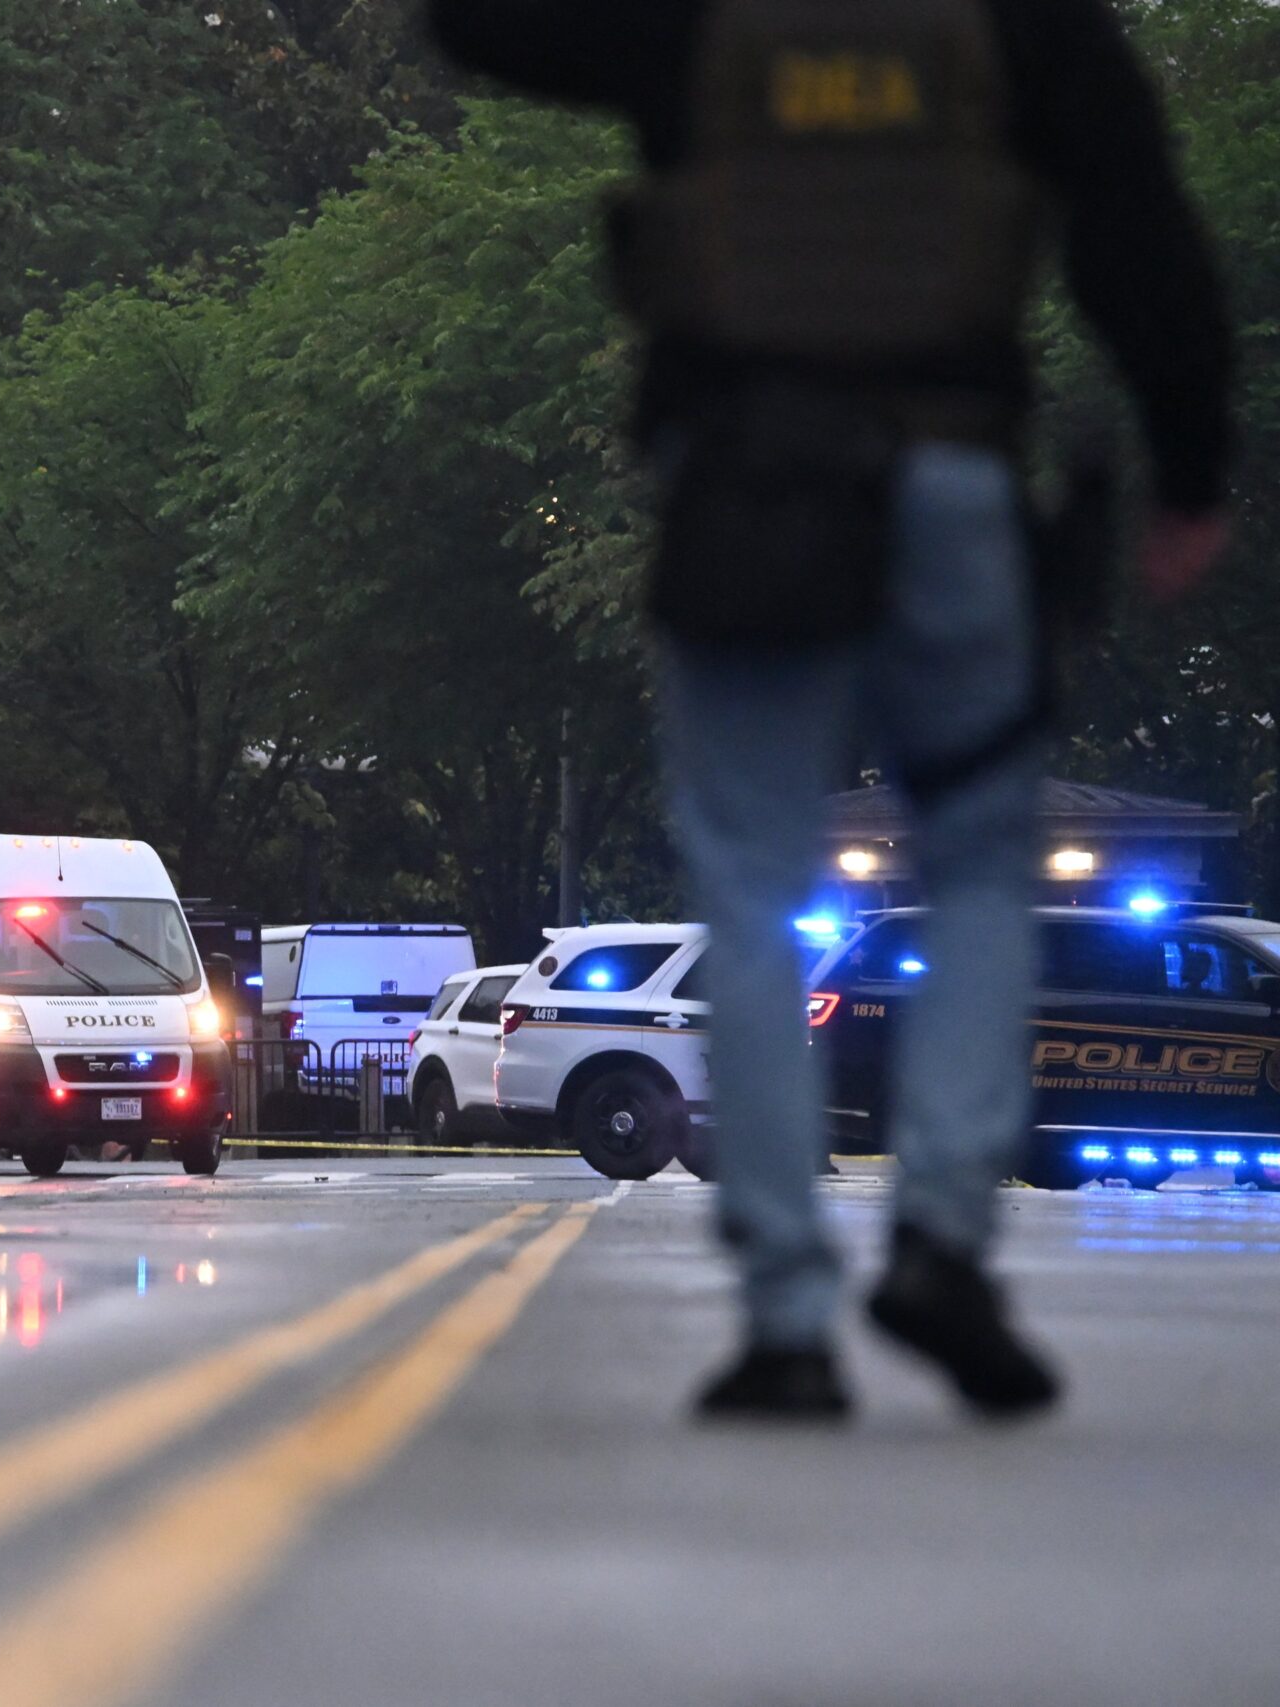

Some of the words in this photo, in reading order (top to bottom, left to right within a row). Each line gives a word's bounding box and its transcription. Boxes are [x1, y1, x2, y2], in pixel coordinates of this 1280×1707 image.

[532, 1007, 558, 1021] 4413
[852, 1003, 886, 1017] 1874
[64, 1015, 156, 1028] POLICE
[1032, 1040, 1263, 1078] POLICE
[88, 1062, 149, 1072] RAM
[1032, 1075, 1083, 1090] UNITED
[1084, 1076, 1138, 1092] STATES
[1139, 1079, 1193, 1094] SECRET
[1194, 1080, 1257, 1096] SERVICE
